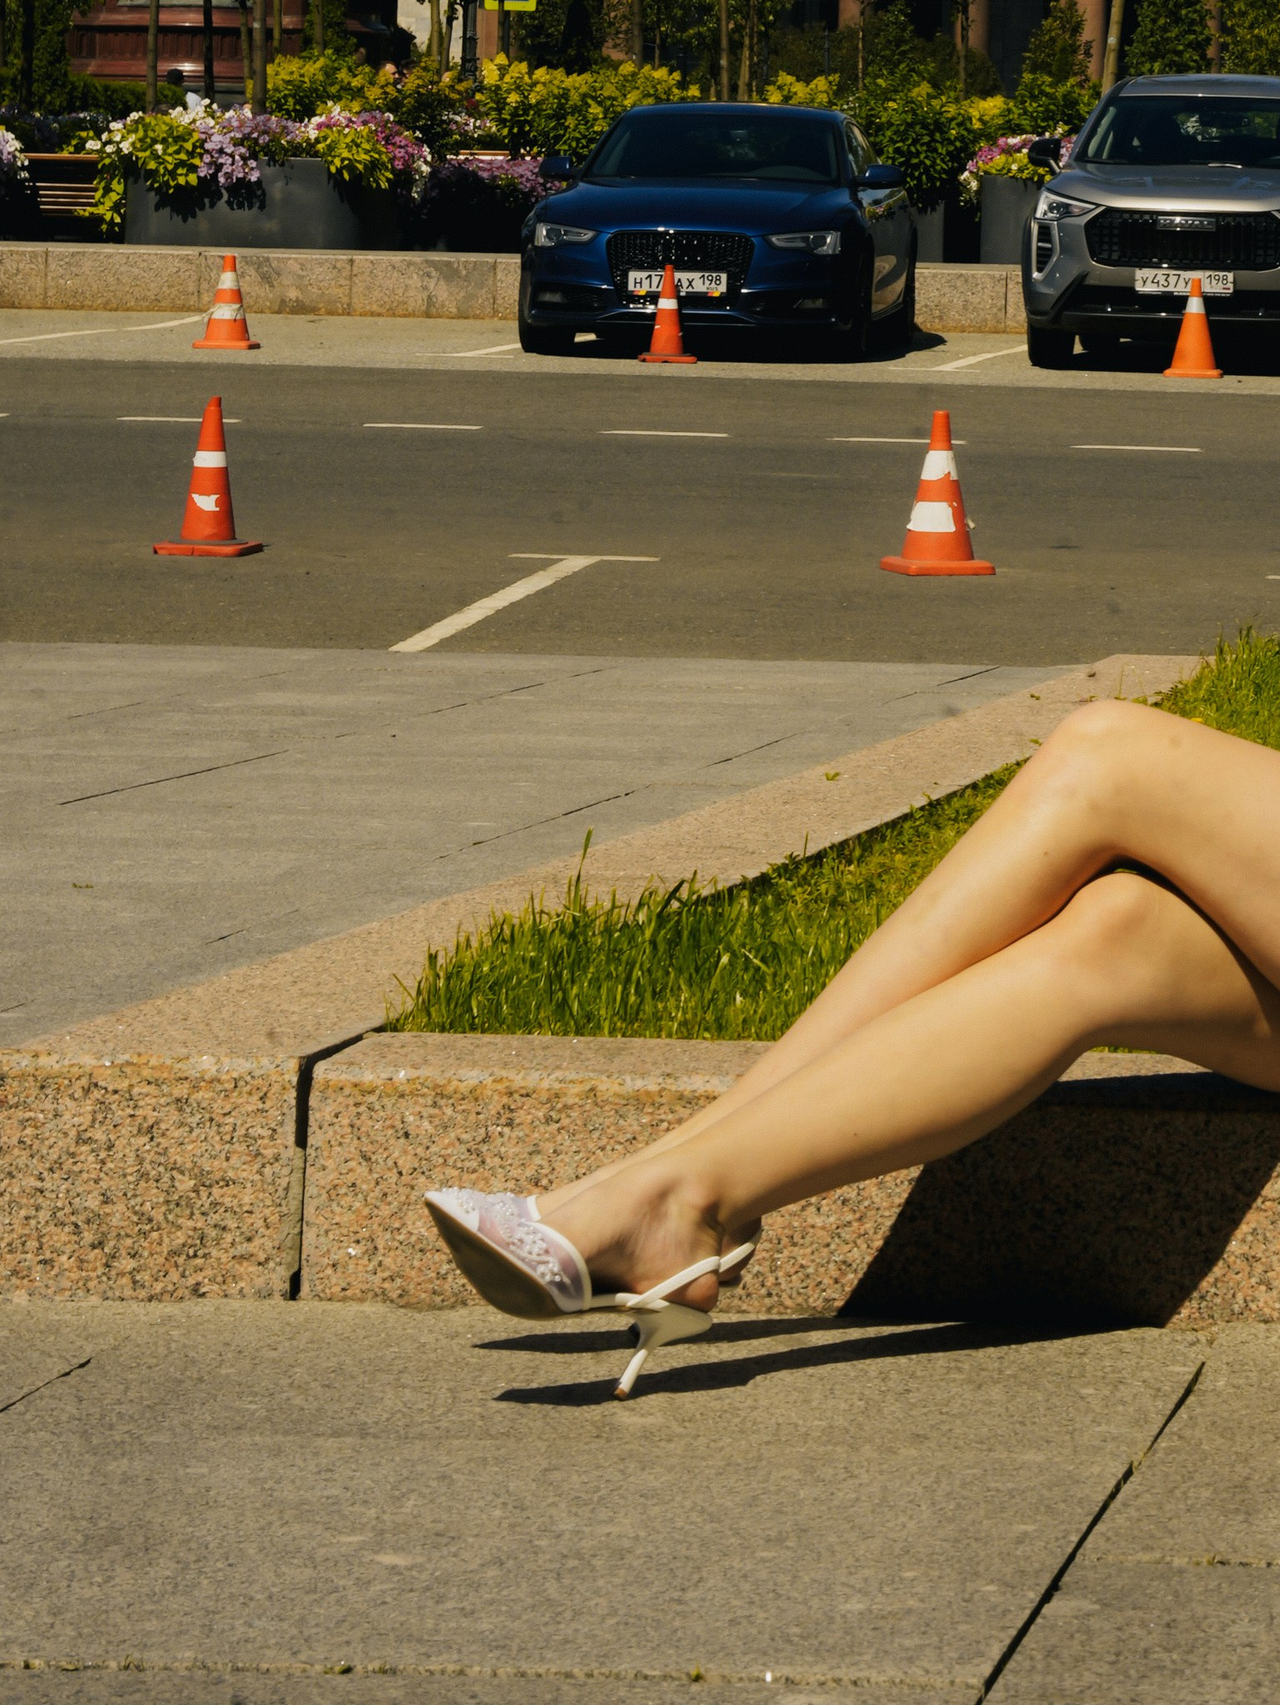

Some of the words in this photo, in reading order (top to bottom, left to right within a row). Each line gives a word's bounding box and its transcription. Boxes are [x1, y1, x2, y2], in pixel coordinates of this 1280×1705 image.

[633, 274, 695, 290] Н17АХ
[698, 274, 722, 286] 198
[1140, 273, 1198, 289] У437У
[1206, 273, 1229, 286] 198
